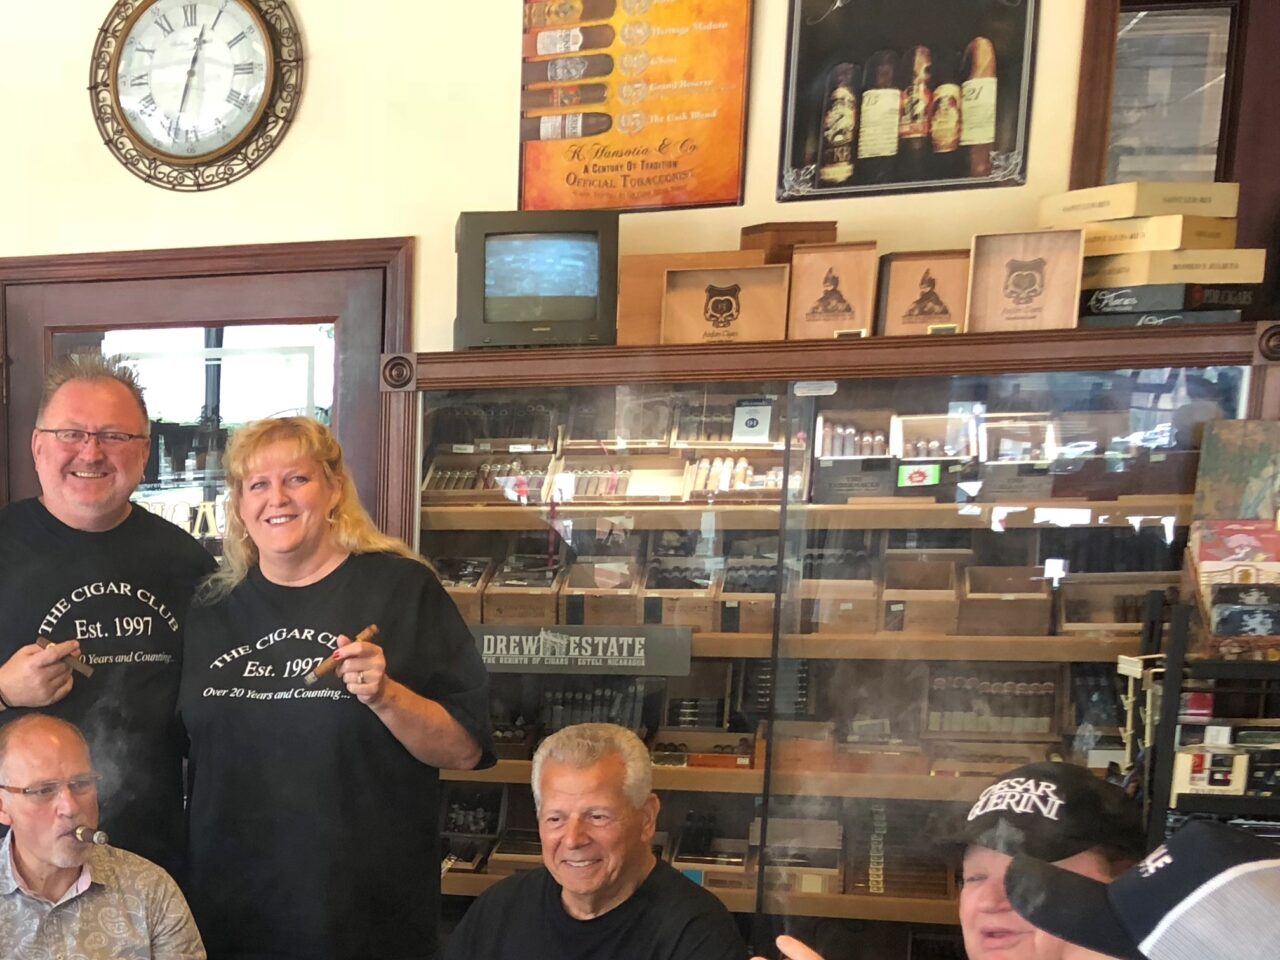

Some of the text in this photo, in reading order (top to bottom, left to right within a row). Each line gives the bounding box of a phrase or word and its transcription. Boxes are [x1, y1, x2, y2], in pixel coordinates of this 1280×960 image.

[640, 160, 678, 170] TRADITION
[566, 172, 616, 188] OFFICIAL
[38, 582, 179, 635] THE CIGAR CLUB
[74, 617, 153, 640] Est. 1997
[210, 628, 338, 670] THE CIGAR CL
[483, 635, 646, 657] DREW ESTATE
[88, 653, 114, 664] Years
[115, 652, 133, 663] and
[242, 657, 324, 678] Est. 1997
[203, 687, 351, 700] Over 20 Years and Counting...
